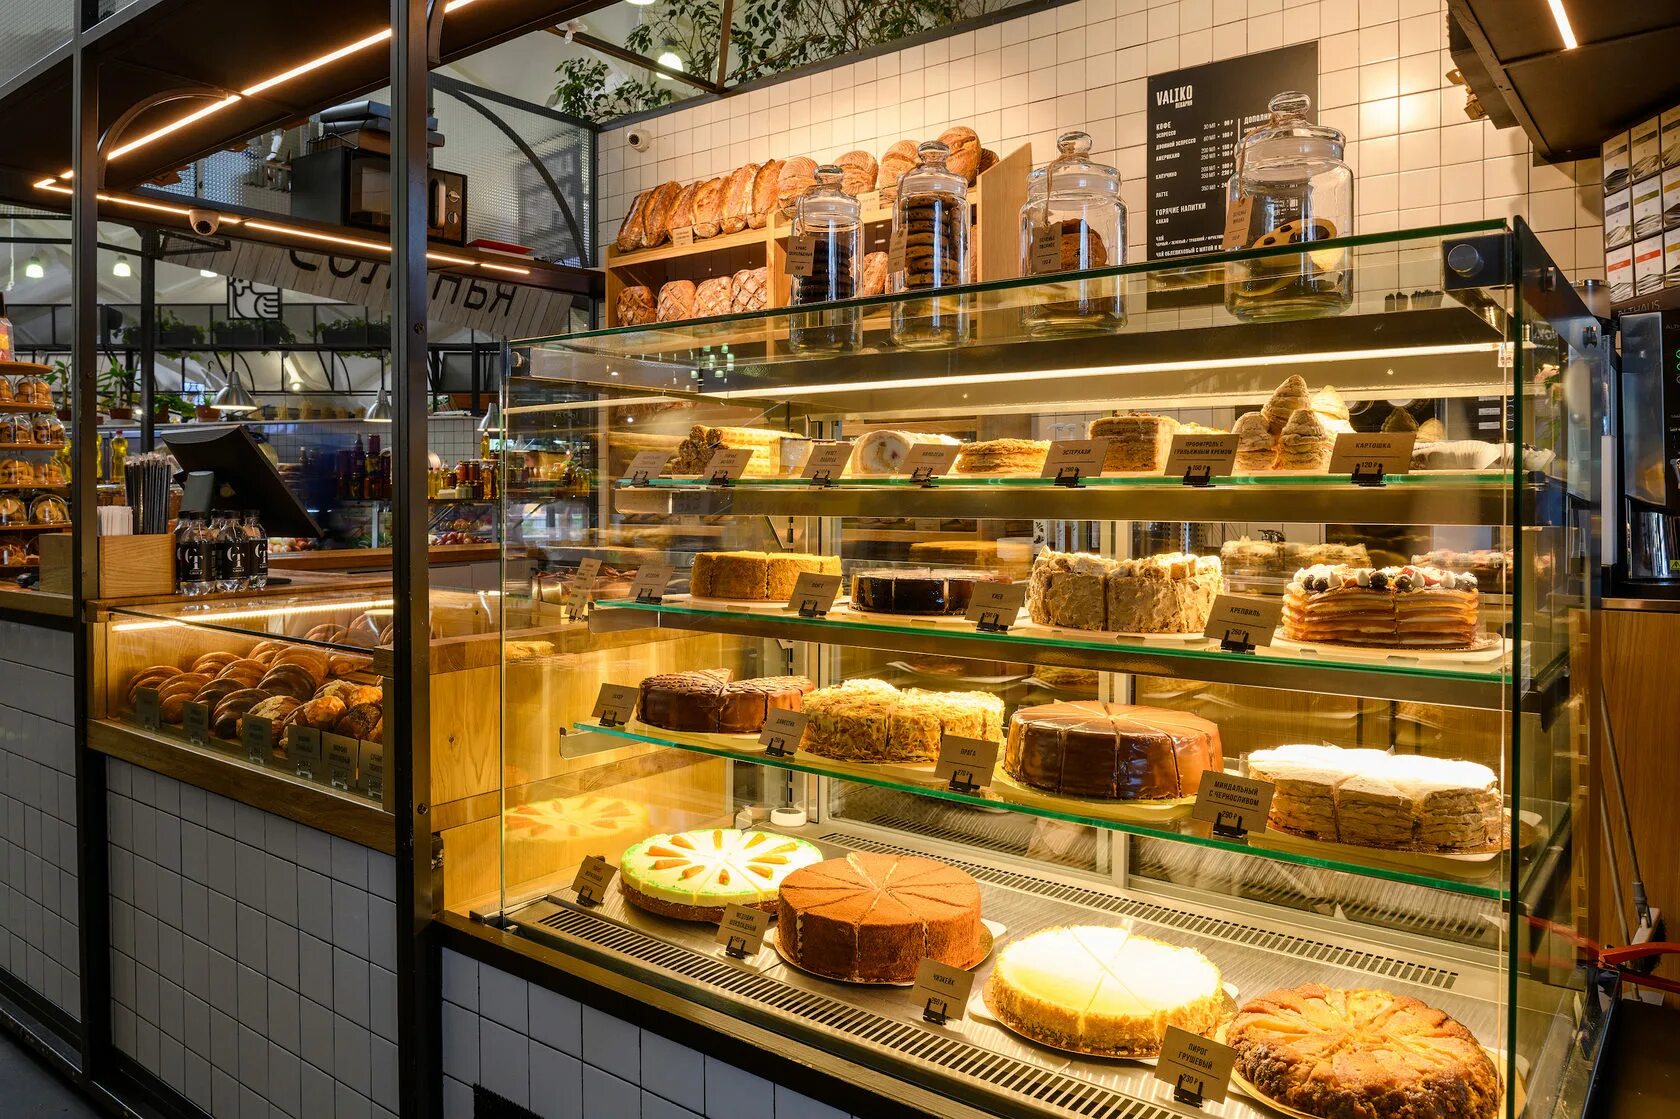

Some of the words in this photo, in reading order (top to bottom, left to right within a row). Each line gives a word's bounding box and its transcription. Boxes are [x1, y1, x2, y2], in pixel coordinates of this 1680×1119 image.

[1156, 85, 1193, 106] VALIKO
[1156, 121, 1172, 131] КОФЕ
[1156, 130, 1177, 139] ЭСПРЕССО
[1156, 141, 1176, 151] ДВОЙНОЙ
[1175, 138, 1197, 147] ЭСПРЕССО
[1155, 171, 1178, 180] КАПУЧИНО
[1155, 206, 1180, 216] ГОРЯЧИЕ
[1180, 202, 1207, 213] НАПИТКИ
[1361, 461, 1373, 469] 120
[1229, 607, 1261, 617] КРЕПВИЛЬ
[960, 748, 976, 757] ПРАГА
[1214, 780, 1259, 796] МИНДАЛЬНЫЙ
[1214, 791, 1259, 807] ЧЕРНОСЛИВОМ
[1221, 810, 1233, 819] 290
[933, 973, 954, 986] ЧИЗКЕЙК
[1188, 1042, 1208, 1056] ПИРОГ
[1177, 1051, 1213, 1071] ГРУШЕВЫЙ
[1182, 1073, 1194, 1084] 230
